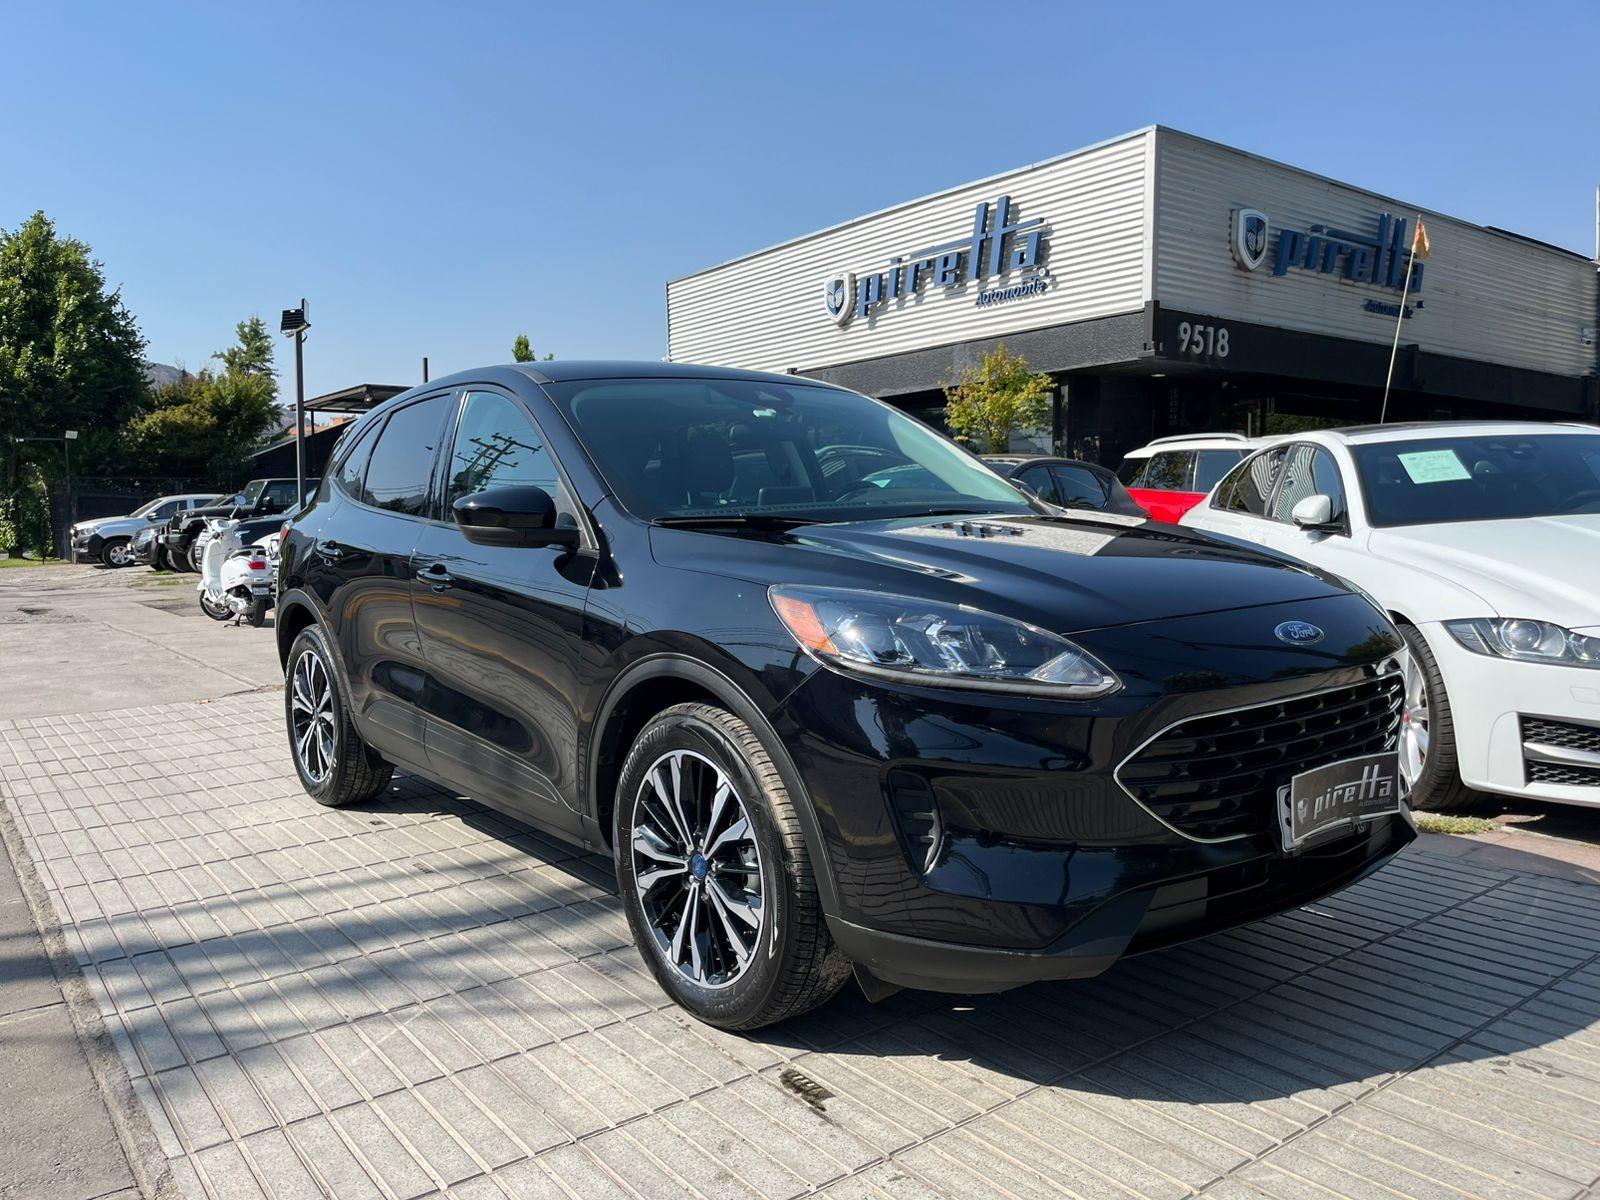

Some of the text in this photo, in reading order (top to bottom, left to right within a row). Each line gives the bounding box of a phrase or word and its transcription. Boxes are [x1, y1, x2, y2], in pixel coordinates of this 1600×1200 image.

[857, 195, 1044, 316] piretta
[1273, 213, 1424, 293] piretta
[1178, 321, 1229, 358] 9518
[1288, 625, 1315, 639] Ford
[1313, 764, 1393, 820] piretta
